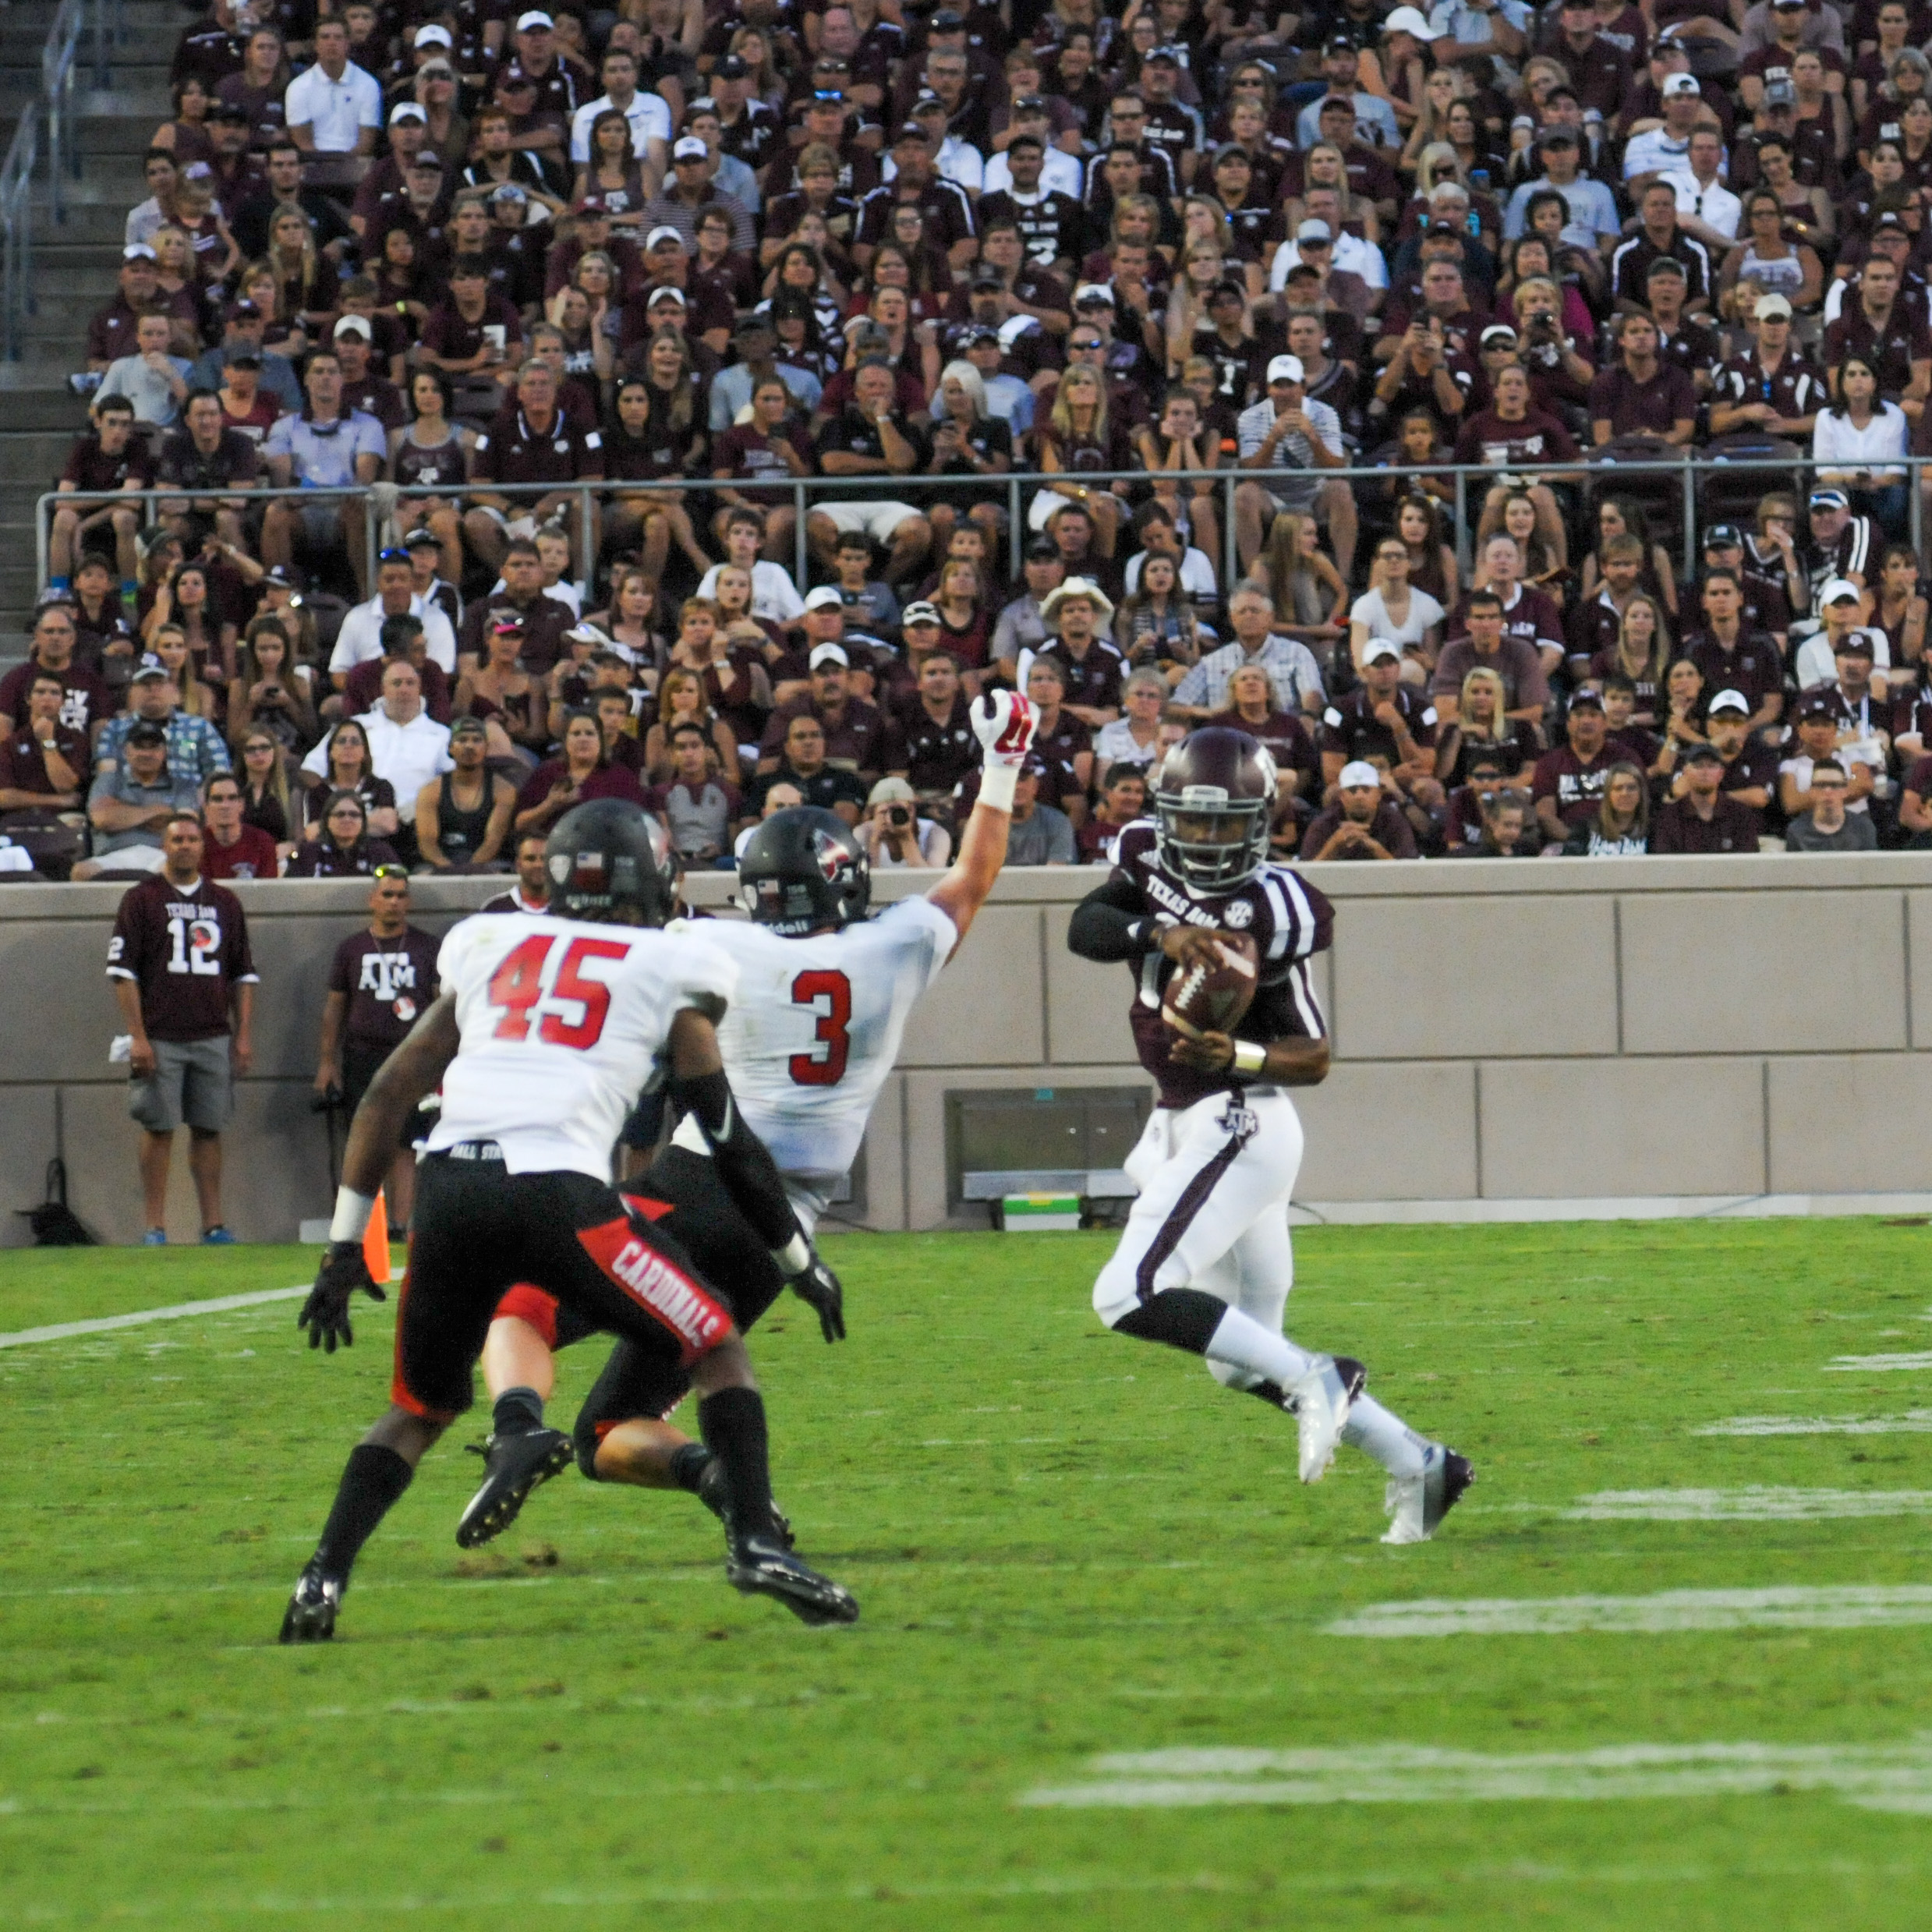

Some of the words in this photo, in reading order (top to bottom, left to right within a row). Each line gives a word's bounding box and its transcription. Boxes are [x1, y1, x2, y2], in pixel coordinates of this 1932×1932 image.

[1148, 873, 1190, 916] TEXAS
[167, 918, 221, 975] 12
[487, 933, 632, 1050] 45
[788, 969, 852, 1086] 3
